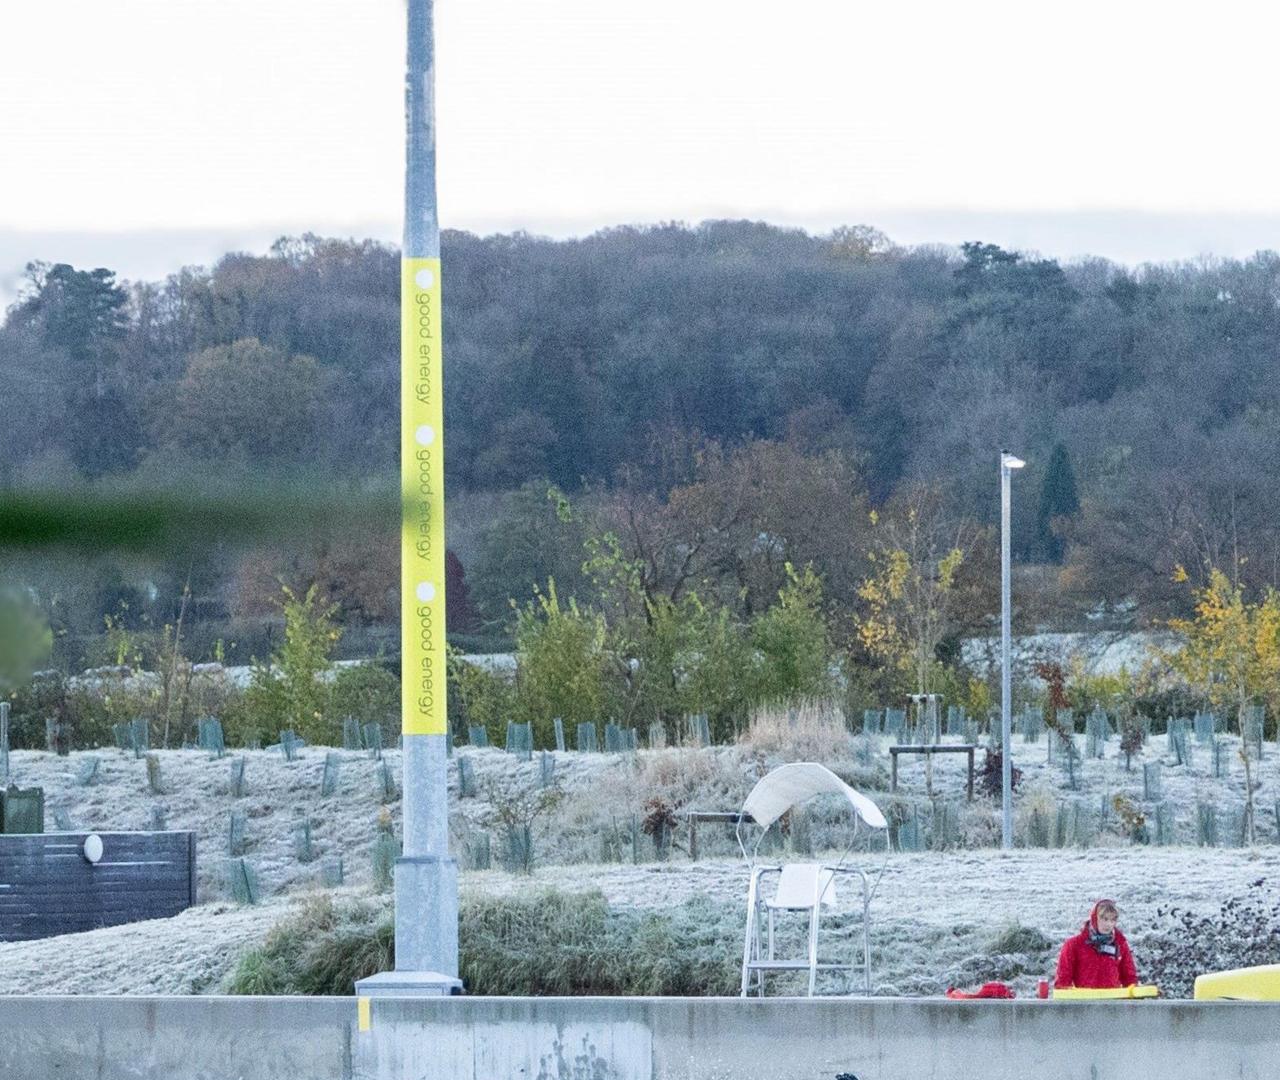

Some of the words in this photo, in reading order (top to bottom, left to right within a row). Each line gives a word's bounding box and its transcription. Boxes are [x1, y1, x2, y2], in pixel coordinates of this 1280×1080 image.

[415, 293, 433, 339] good
[415, 344, 431, 405] energy
[416, 449, 434, 495] good
[416, 501, 431, 561] energy
[417, 606, 436, 651] good
[418, 657, 433, 717] energy
